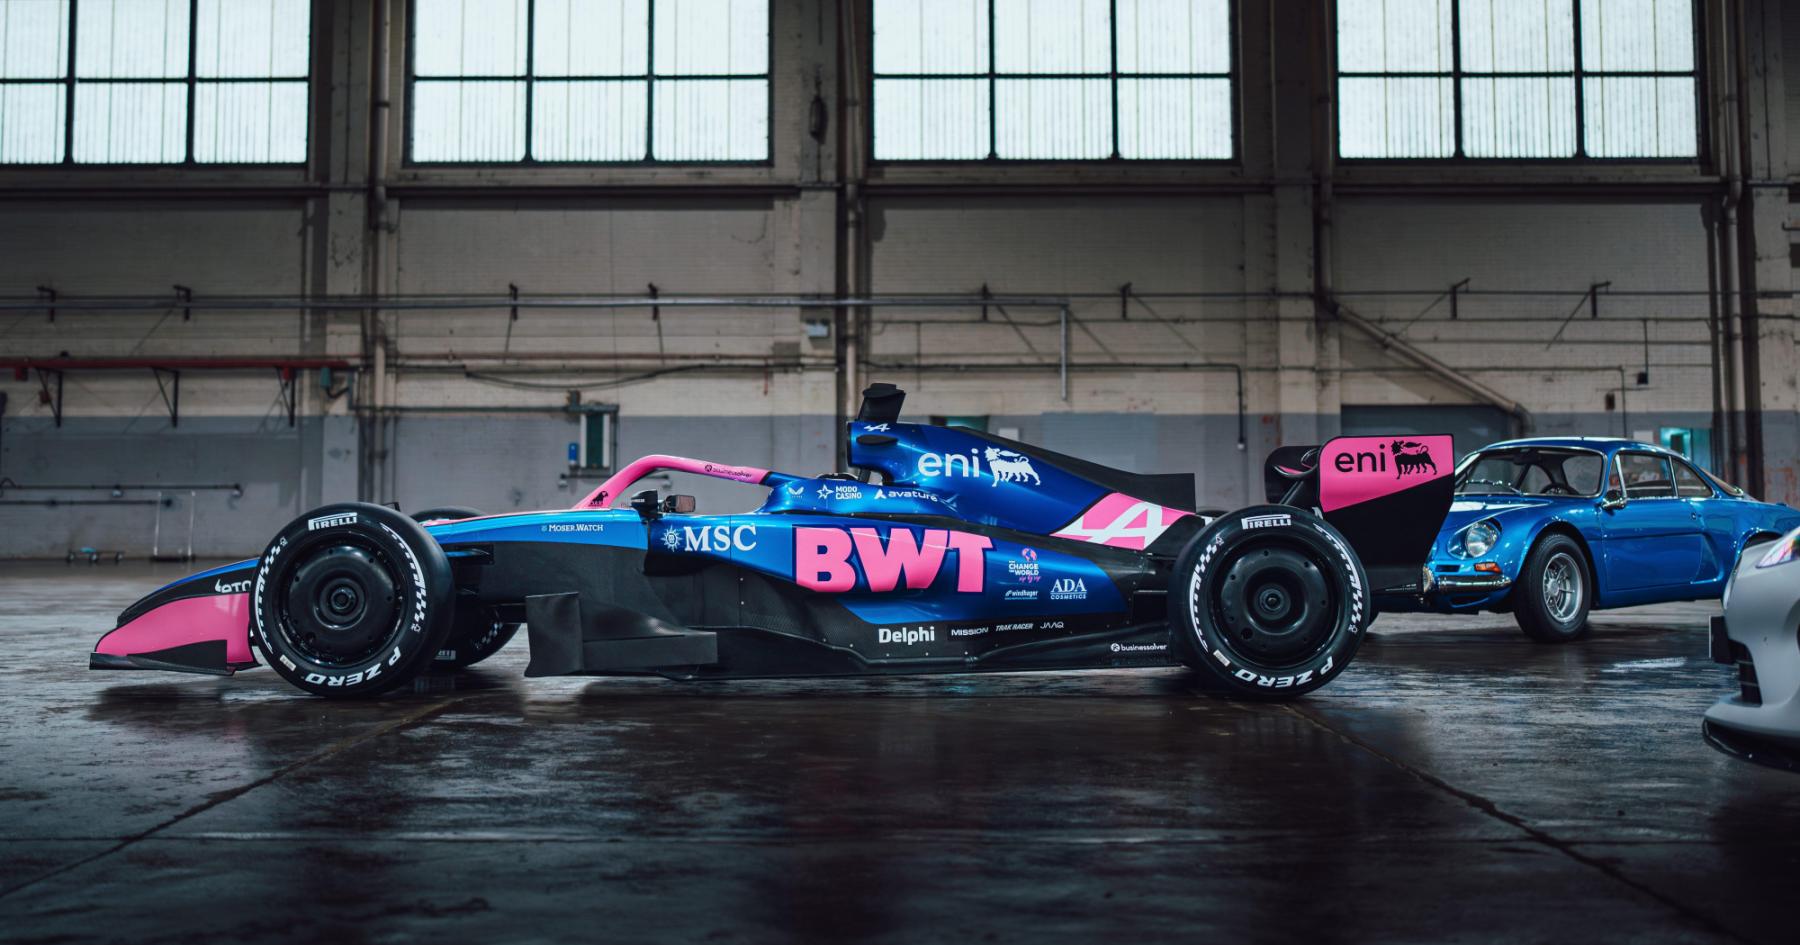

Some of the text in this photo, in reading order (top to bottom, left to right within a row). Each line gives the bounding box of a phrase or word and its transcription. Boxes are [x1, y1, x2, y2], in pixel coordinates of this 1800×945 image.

[918, 448, 980, 478] eni
[1335, 444, 1386, 473] eni
[835, 485, 858, 493] MODO
[835, 492, 862, 500] CASINO
[888, 490, 938, 502] avature
[308, 511, 358, 531] PIRELLI
[1241, 513, 1292, 530] PIRELLI
[683, 523, 757, 552] MSC
[796, 527, 993, 593] BWT
[1050, 577, 1088, 593] ADA
[878, 626, 936, 645] Delphi
[951, 627, 989, 636] MISSION
[995, 622, 1034, 632] TRAK RACER
[305, 646, 401, 687] P ZERO
[1234, 655, 1334, 688] P ZERO
